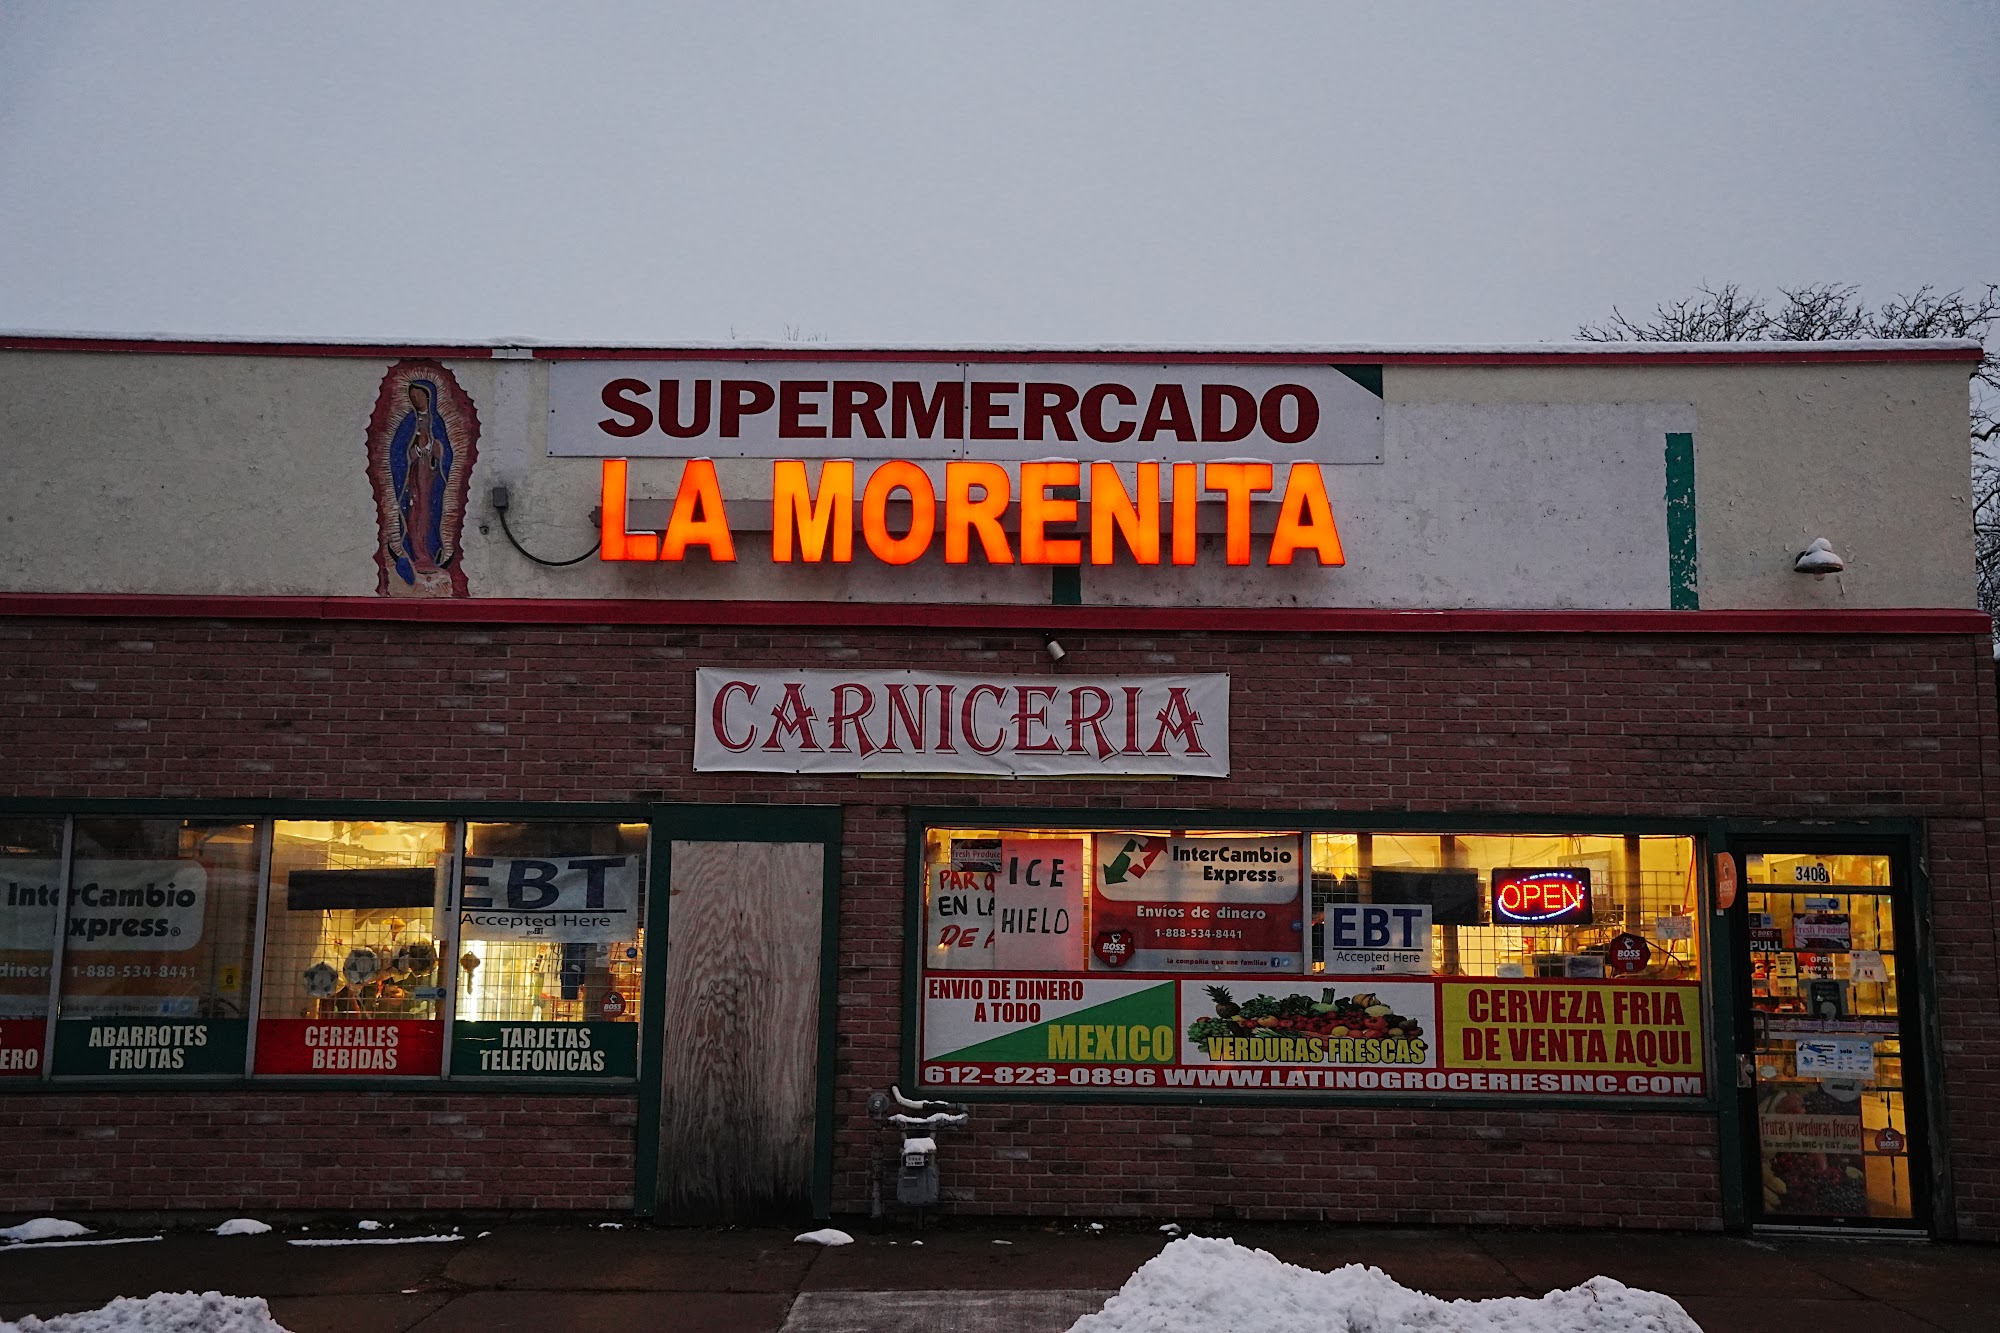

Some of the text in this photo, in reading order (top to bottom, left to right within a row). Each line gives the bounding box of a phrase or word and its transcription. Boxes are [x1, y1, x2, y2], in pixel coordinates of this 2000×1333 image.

[597, 377, 1320, 444] SUPERMERCADO
[601, 458, 1346, 567] LA MORENITA
[712, 680, 1212, 761] CARNICERIA
[1172, 845, 1292, 864] InterCambio
[448, 857, 626, 909] EBT
[1010, 857, 1065, 888] ICE
[1795, 866, 1826, 882] 3408
[938, 896, 968, 917] EN
[1501, 884, 1582, 909] OPEN
[460, 913, 611, 928] Accepted Here
[1001, 908, 1069, 934] HIELO
[1191, 906, 1210, 918] de
[1216, 907, 1266, 920] dinero
[939, 925, 979, 948] DE
[1155, 928, 1242, 939] 1-888-534-8441
[1333, 907, 1424, 949] EBT
[1103, 942, 1126, 951] BOSS
[1749, 940, 1782, 951] PULL
[1336, 951, 1420, 964] Accepted Here
[0, 962, 196, 979] diner 1-888-534-8441
[929, 979, 1084, 1001] ENVIO DE DINERO
[974, 1003, 1041, 1023] A TODO
[1468, 988, 1685, 1026] CERVEZA FRIA
[89, 1025, 208, 1047] ABARROTES
[305, 1026, 398, 1047] CEREALES
[500, 1028, 591, 1048] TARJETAS
[1048, 1024, 1174, 1062] MEXICO
[1462, 1026, 1693, 1068] DE VENTA AQUI
[109, 1047, 185, 1070] FRUTAS
[312, 1048, 398, 1070] BEBIDAS
[479, 1049, 606, 1071] TELEFONICAS
[1208, 1036, 1426, 1064] VERDURAS FRESCAS
[924, 1066, 1701, 1095] 612-823-0896 WWW.LATINOGROCERIESINC.COM
[1761, 1116, 1860, 1141] Frutas y verduras frescas
[1802, 1141, 1818, 1149] WIC
